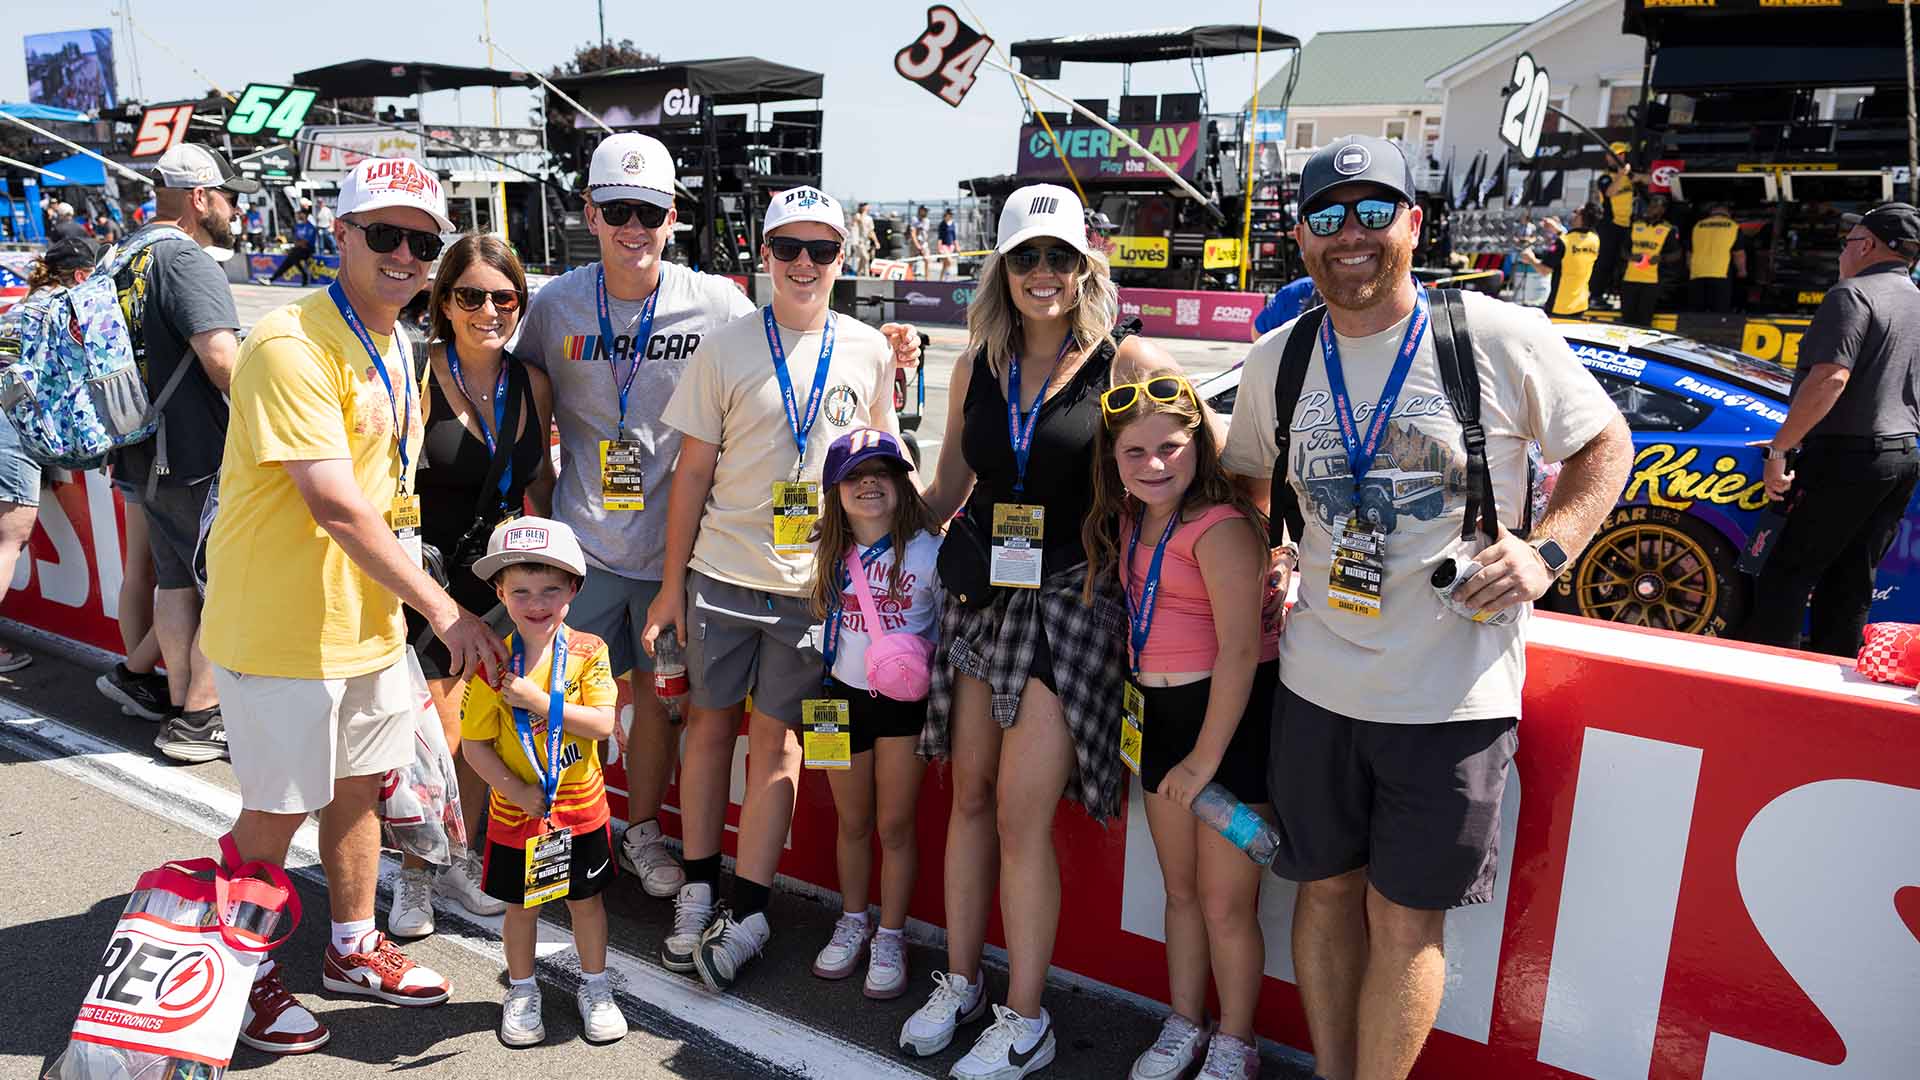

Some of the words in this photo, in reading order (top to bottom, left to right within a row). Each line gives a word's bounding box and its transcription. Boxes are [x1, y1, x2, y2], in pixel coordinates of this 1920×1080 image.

[897, 8, 992, 105] 34
[226, 84, 316, 138] 54
[1502, 52, 1550, 158] 20
[133, 106, 193, 156] 51
[1125, 159, 1145, 172] the
[388, 173, 425, 193] 22
[1120, 244, 1165, 262] Love's
[1213, 306, 1252, 317] FORD
[1574, 345, 1647, 370] JACOB
[1291, 390, 1451, 432] Boco
[849, 429, 880, 456] 11
[1307, 428, 1344, 451] For
[96, 1009, 163, 1030] ELECTRONICS
